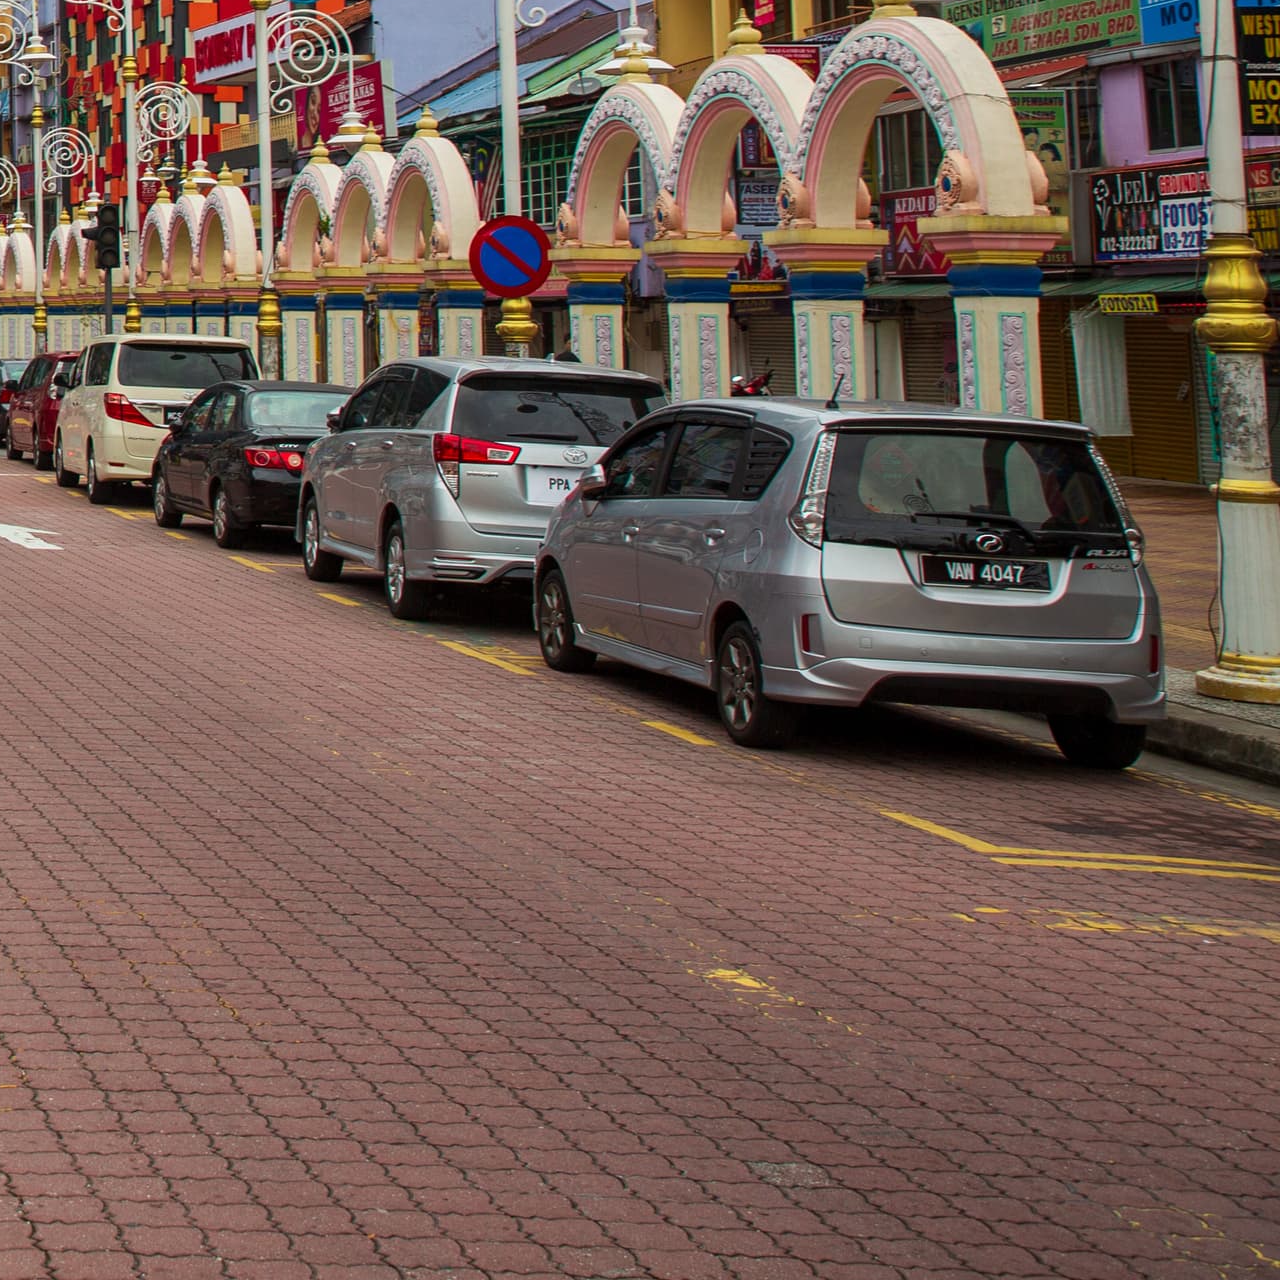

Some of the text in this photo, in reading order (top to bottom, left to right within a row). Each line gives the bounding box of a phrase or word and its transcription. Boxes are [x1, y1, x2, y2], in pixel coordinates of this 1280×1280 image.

[946, 0, 984, 23] AGENSI
[1010, 9, 1054, 34] AGENSI
[991, 14, 1139, 58] JASA TENAGA SDN. BHD.
[327, 83, 376, 108] KANCANAS
[1158, 173, 1197, 195] GROUND
[894, 195, 927, 214] KEDAI
[1100, 296, 1155, 312] FOTOSTAT
[548, 477, 571, 491] PPA
[1086, 548, 1129, 557] ALZA
[944, 561, 1025, 583] VAW 4047
